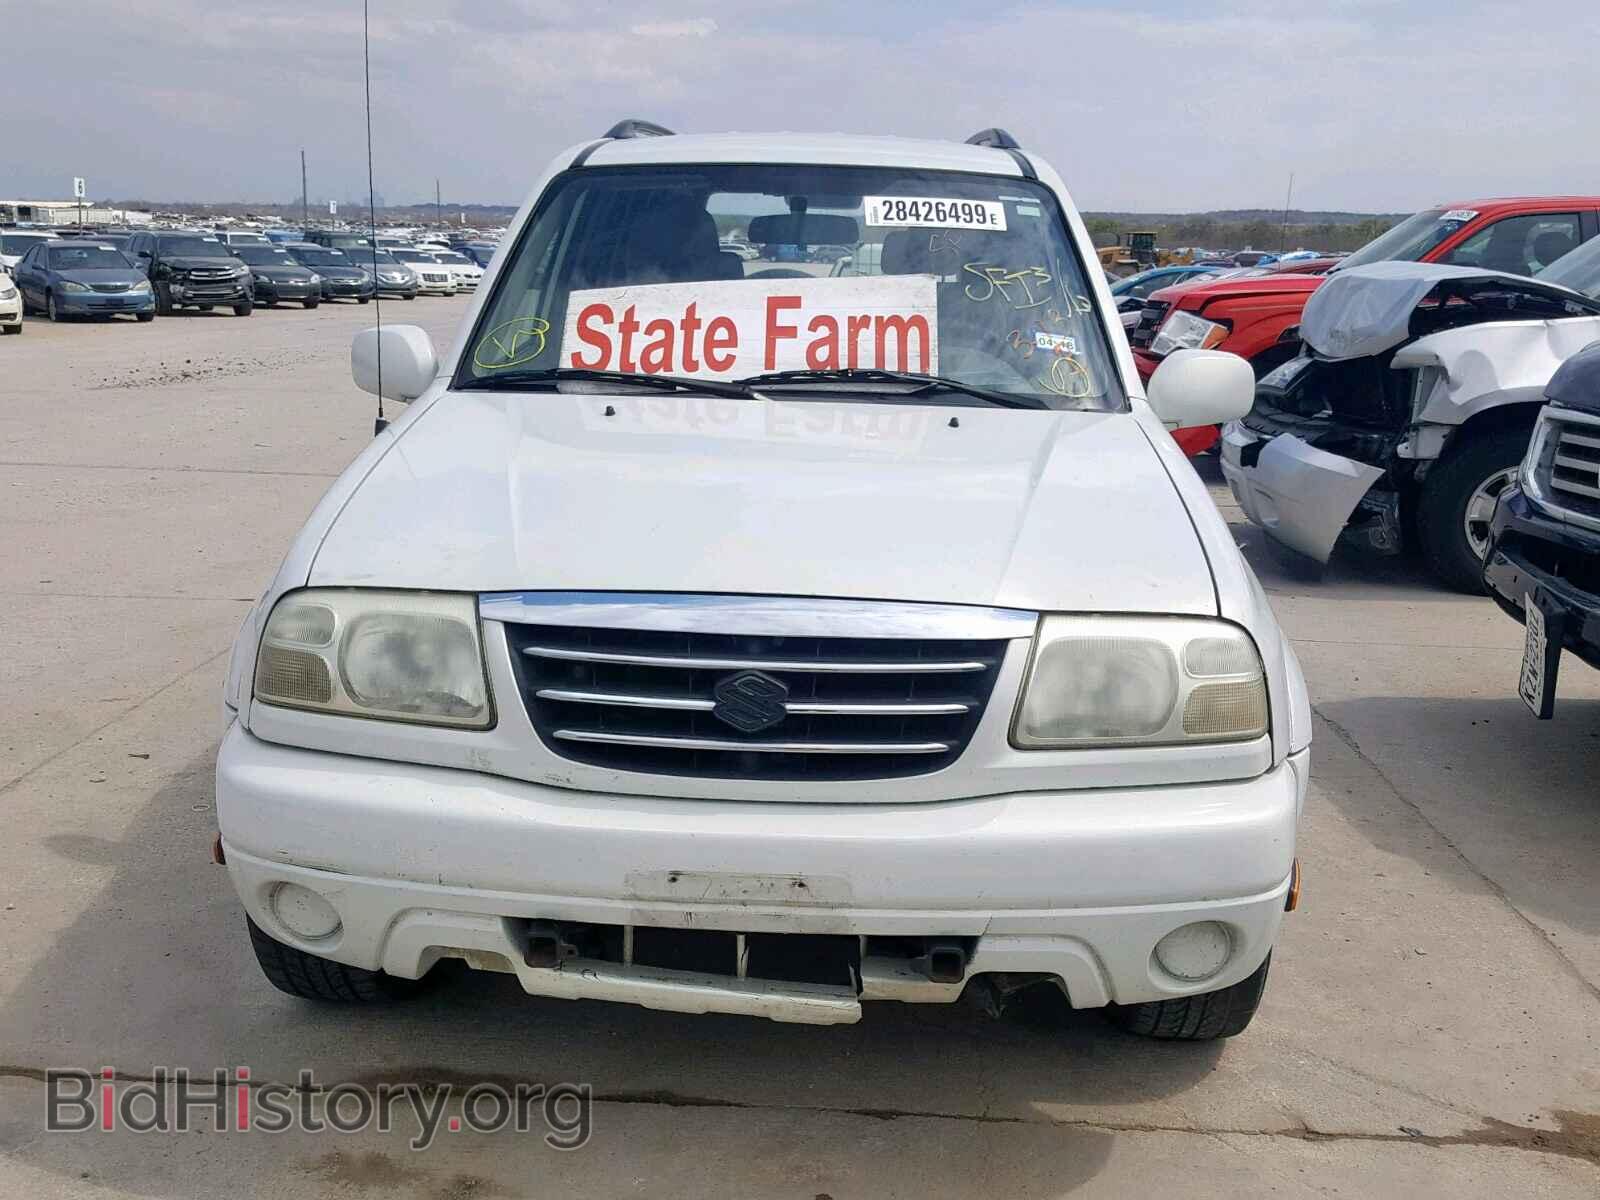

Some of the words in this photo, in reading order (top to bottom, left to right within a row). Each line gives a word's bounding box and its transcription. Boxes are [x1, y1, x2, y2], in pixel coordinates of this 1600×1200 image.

[882, 200, 987, 224] 28426499
[990, 213, 998, 225] E
[570, 300, 738, 374] State
[763, 295, 930, 374] Farm
